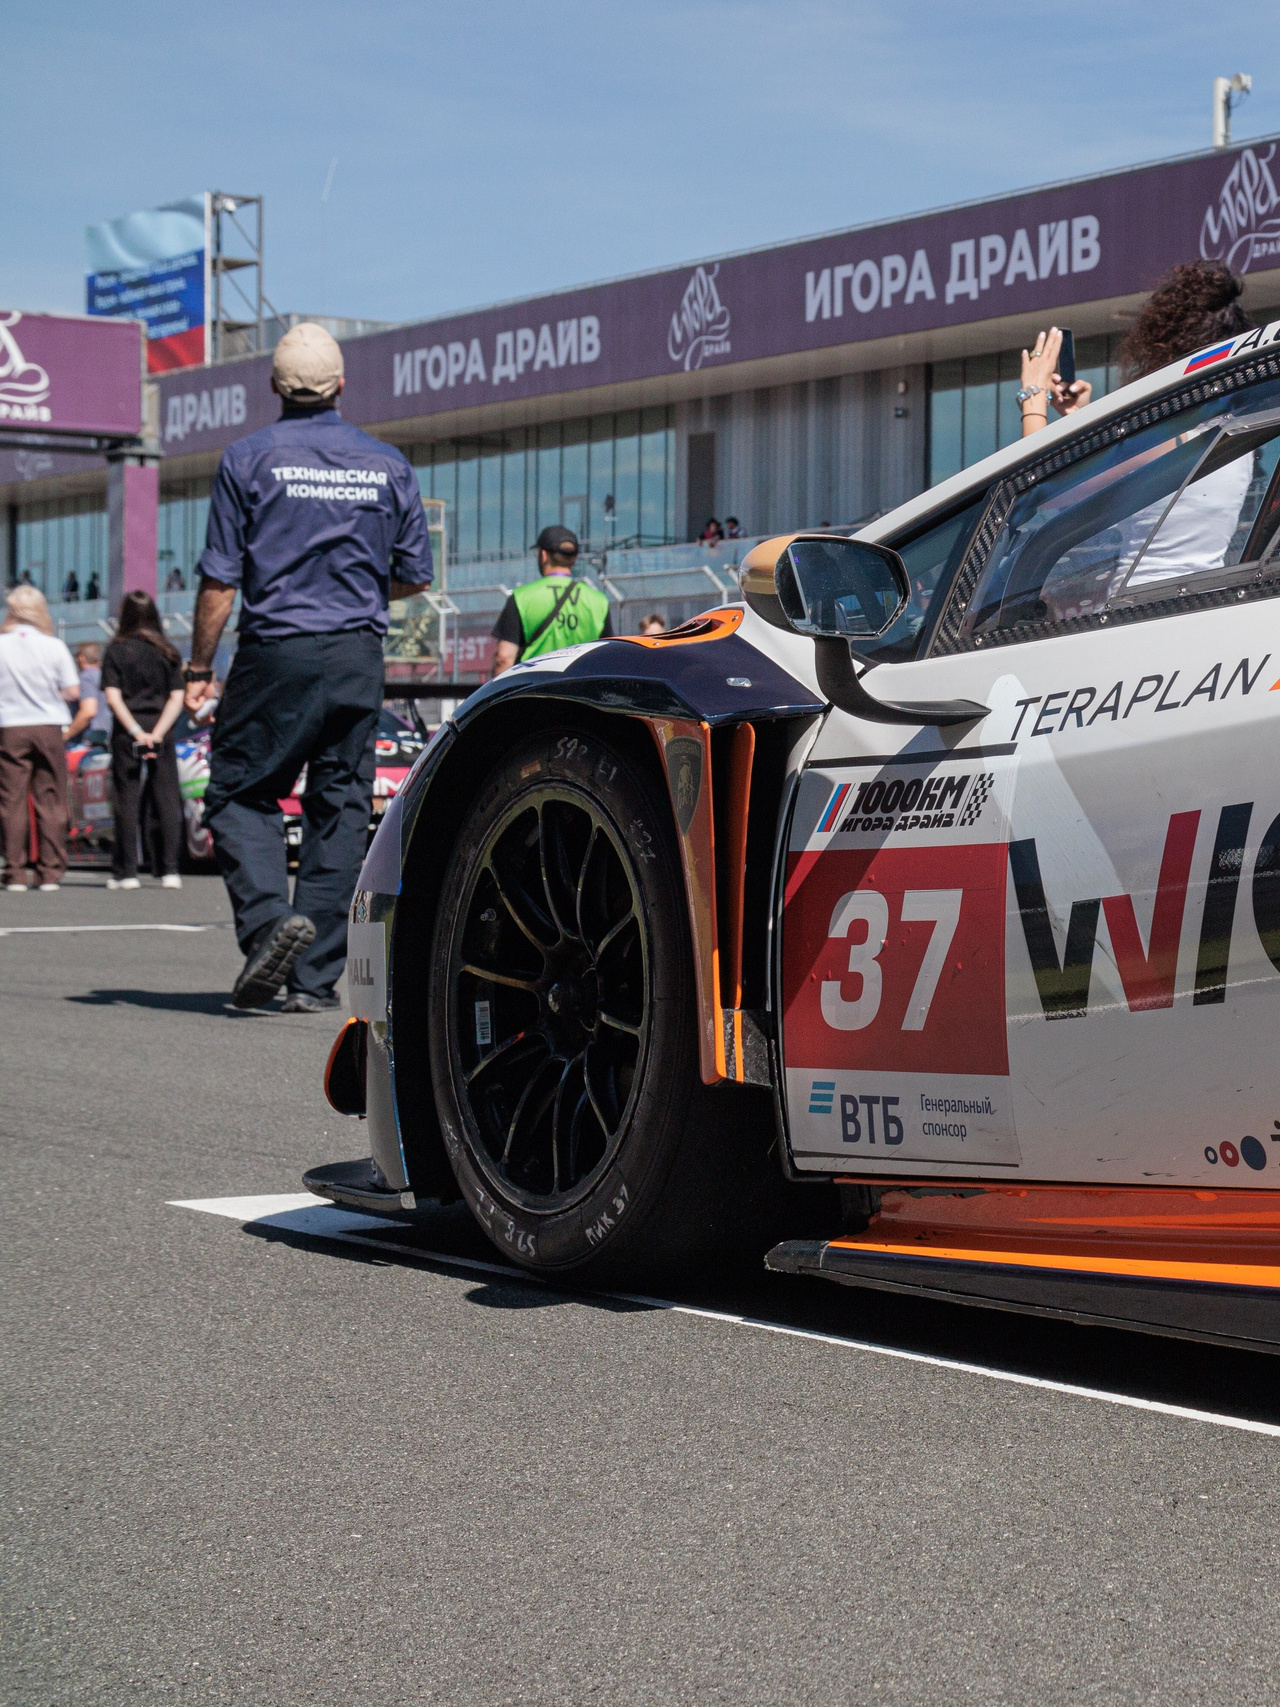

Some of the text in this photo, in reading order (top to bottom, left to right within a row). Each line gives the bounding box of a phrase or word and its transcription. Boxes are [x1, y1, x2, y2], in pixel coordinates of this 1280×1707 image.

[804, 214, 1101, 322] ИГОРА ДРАЙВ
[393, 315, 601, 396] ИГОРА ДРАЙВ
[0, 403, 52, 423] РАЙВ
[270, 466, 388, 486] ТЕХНИЧЕСКАЯ
[286, 483, 379, 501] КОМИССИЯ
[1010, 652, 1272, 742] TERAPLAN
[820, 888, 963, 1033] 37
[840, 1093, 904, 1146] ВТБ
[920, 1093, 992, 1117] Генеральный
[922, 1121, 968, 1142] спонсор
